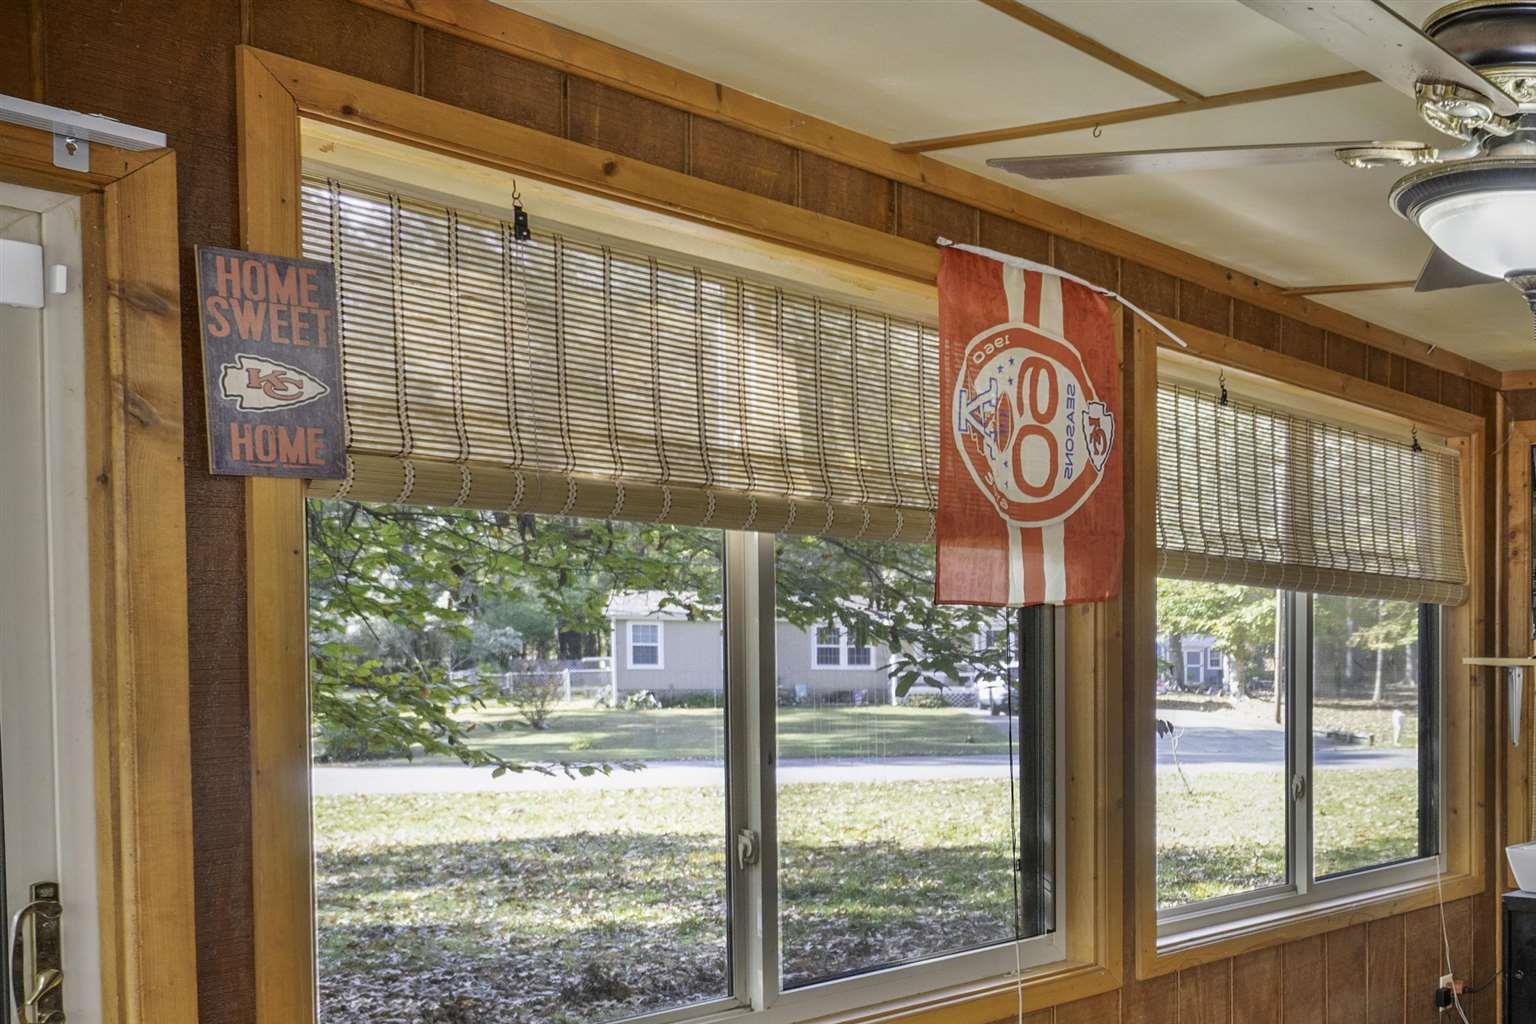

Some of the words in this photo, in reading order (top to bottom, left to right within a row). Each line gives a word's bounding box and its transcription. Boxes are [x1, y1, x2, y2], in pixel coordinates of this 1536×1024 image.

[215, 255, 322, 309] HOME
[207, 296, 332, 350] SWEET
[246, 367, 304, 401] KC
[229, 422, 326, 467] HOME
